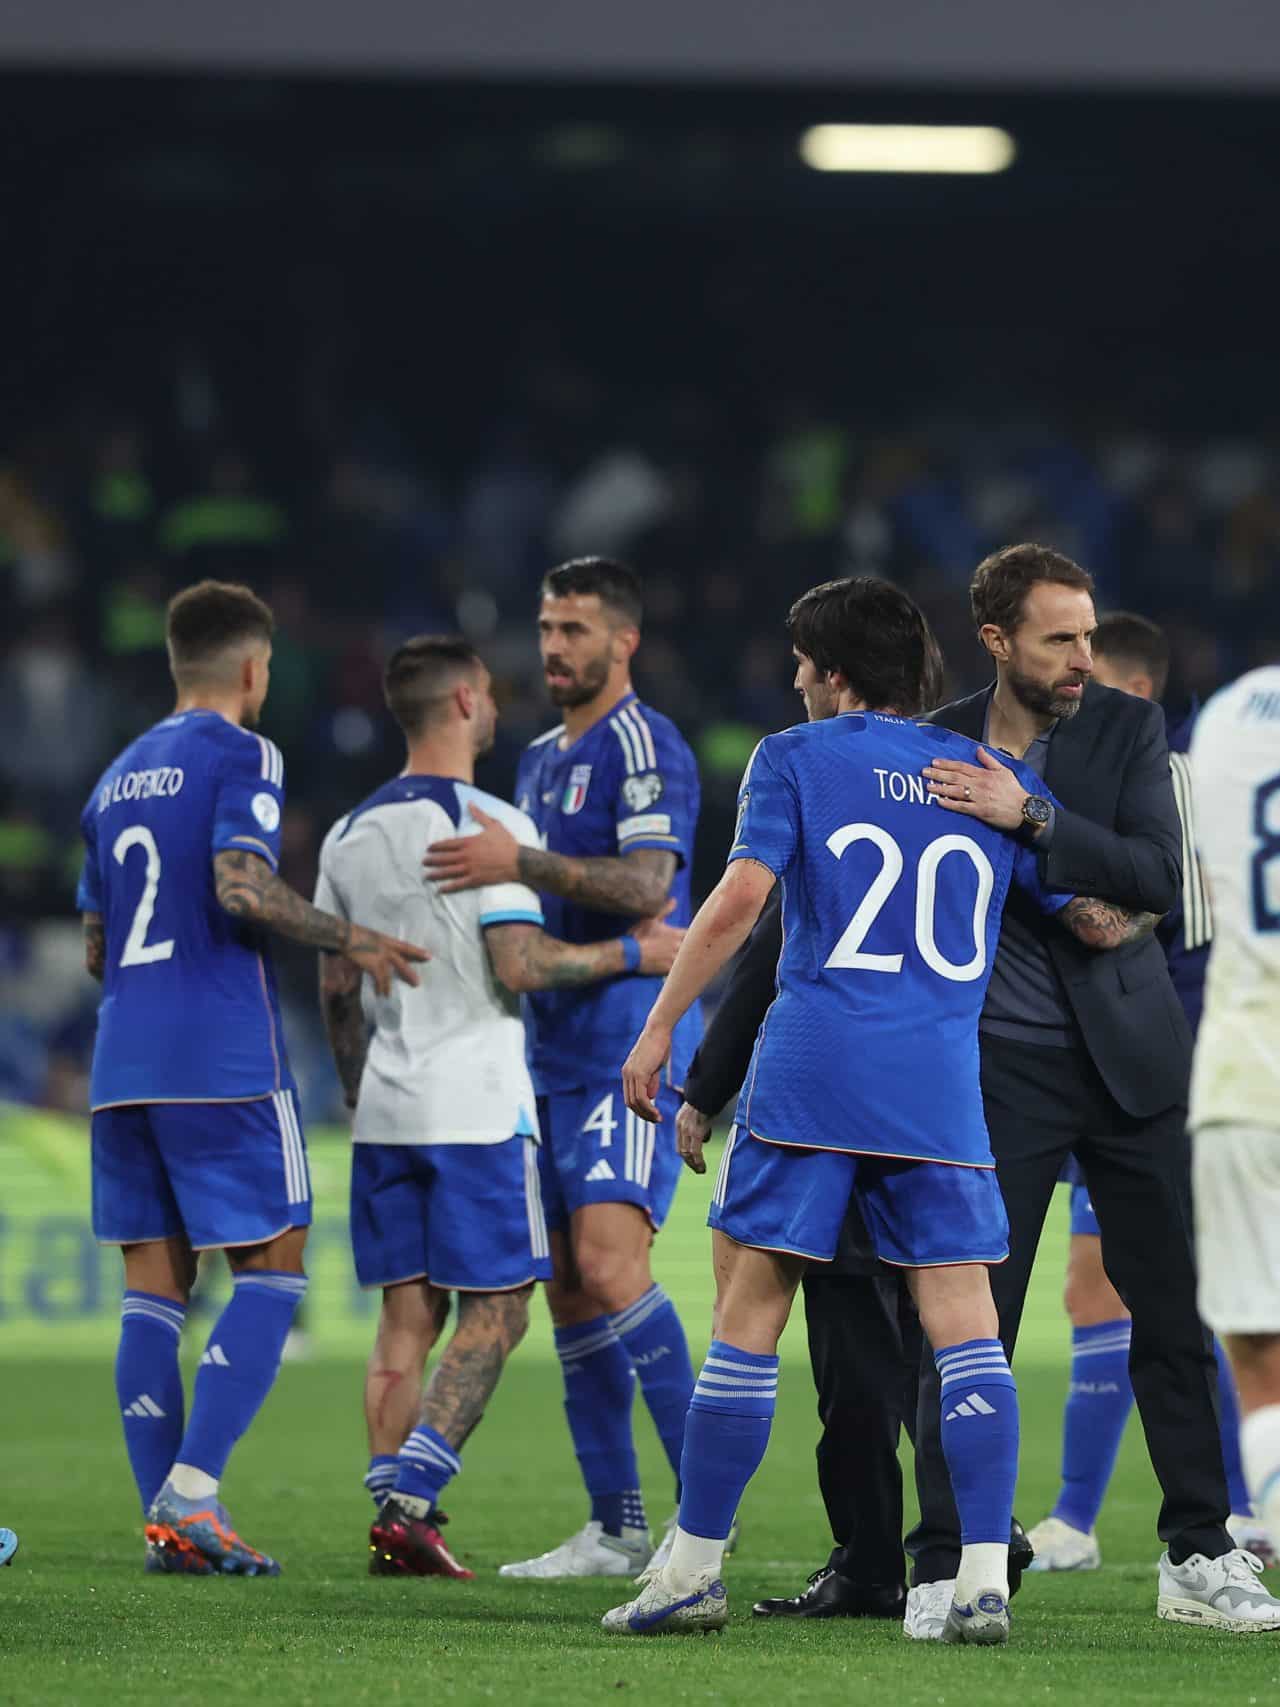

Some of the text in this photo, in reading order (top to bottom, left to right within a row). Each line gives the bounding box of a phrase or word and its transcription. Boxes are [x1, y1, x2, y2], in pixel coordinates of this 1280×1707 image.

[112, 825, 175, 969] 2
[823, 822, 994, 982] 20
[583, 1092, 618, 1148] 4
